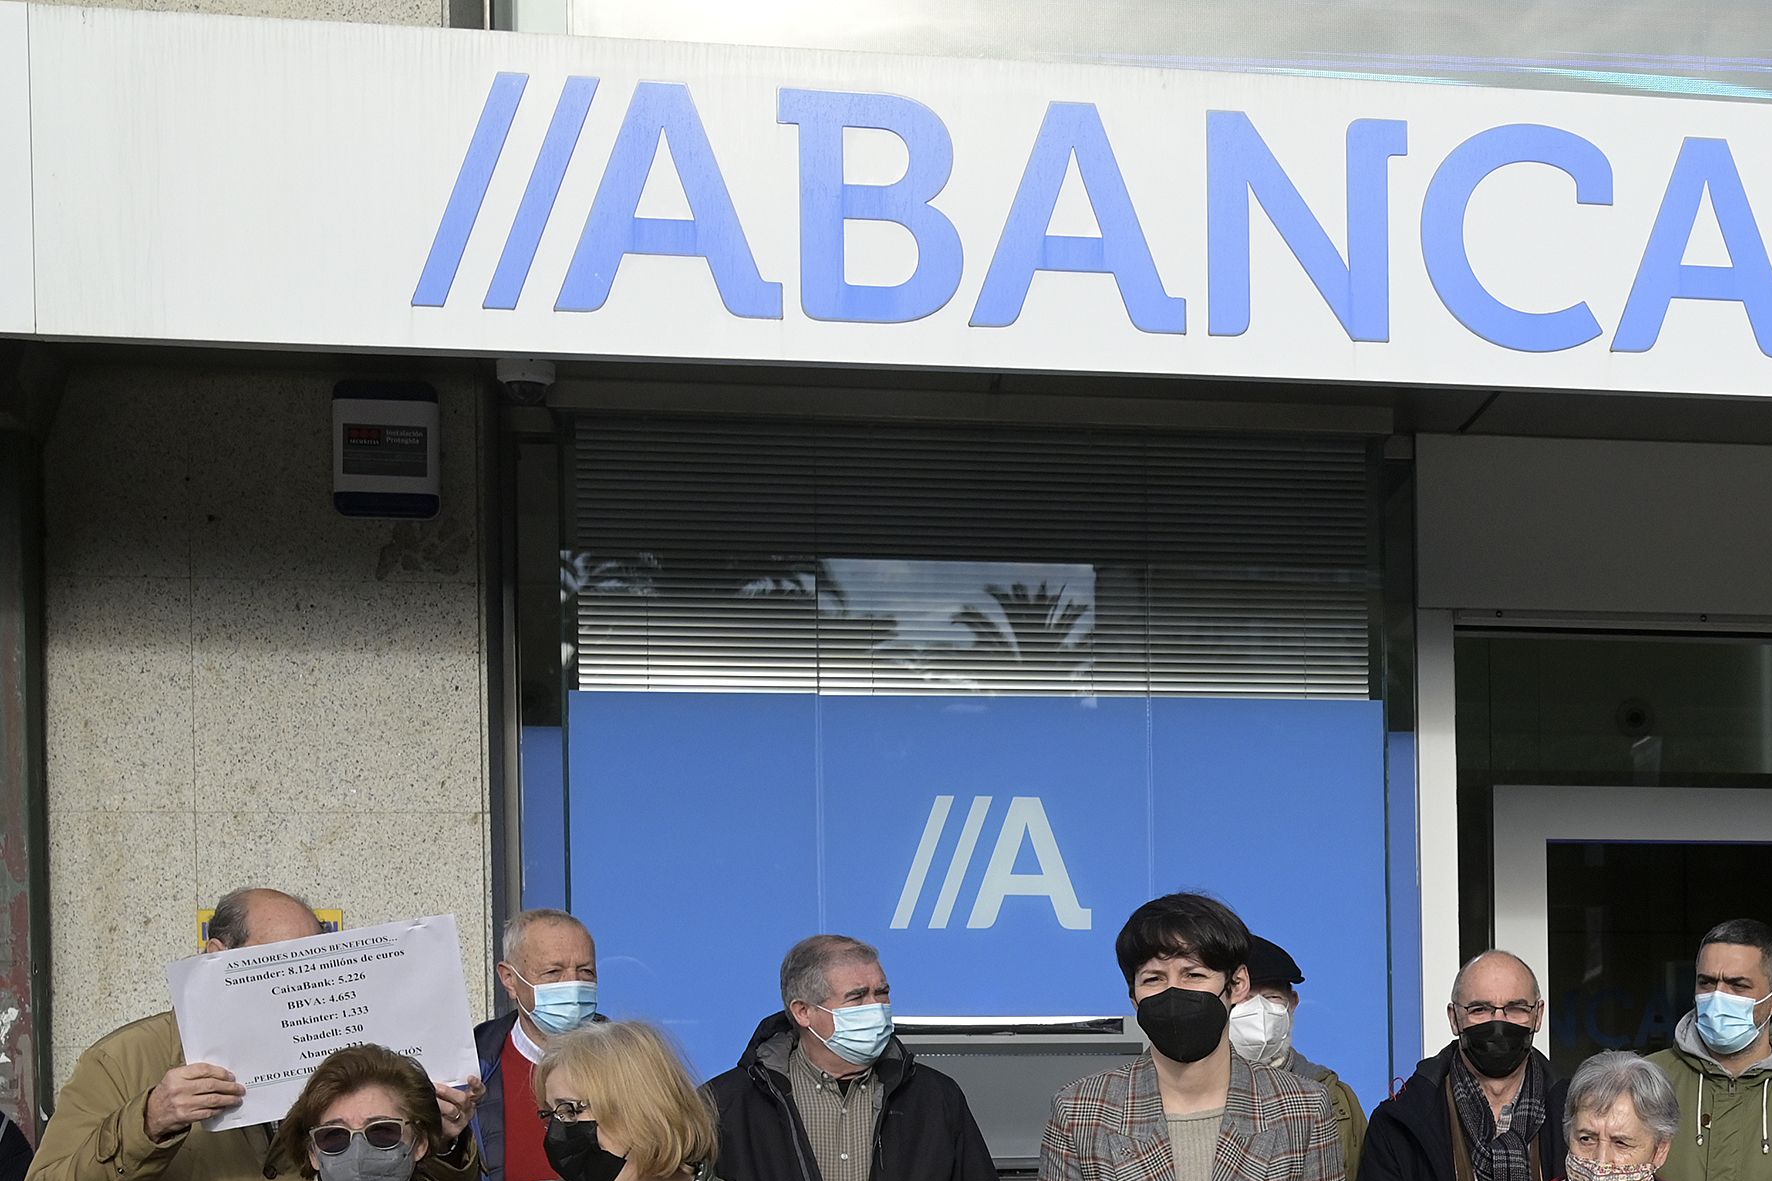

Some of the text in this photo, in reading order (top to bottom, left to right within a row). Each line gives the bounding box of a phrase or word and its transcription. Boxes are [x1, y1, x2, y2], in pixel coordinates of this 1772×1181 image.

[224, 949, 405, 987] Santander: 8.124 millóns de euros
[241, 952, 288, 968] MAIORES
[290, 945, 328, 960] DAMOS
[271, 971, 367, 996] CaixaBank: 5.226
[287, 991, 358, 1011] BBVA: 4.653
[280, 1005, 370, 1030] Bankinter: 1.333
[292, 1023, 364, 1045] Sabadell: 530
